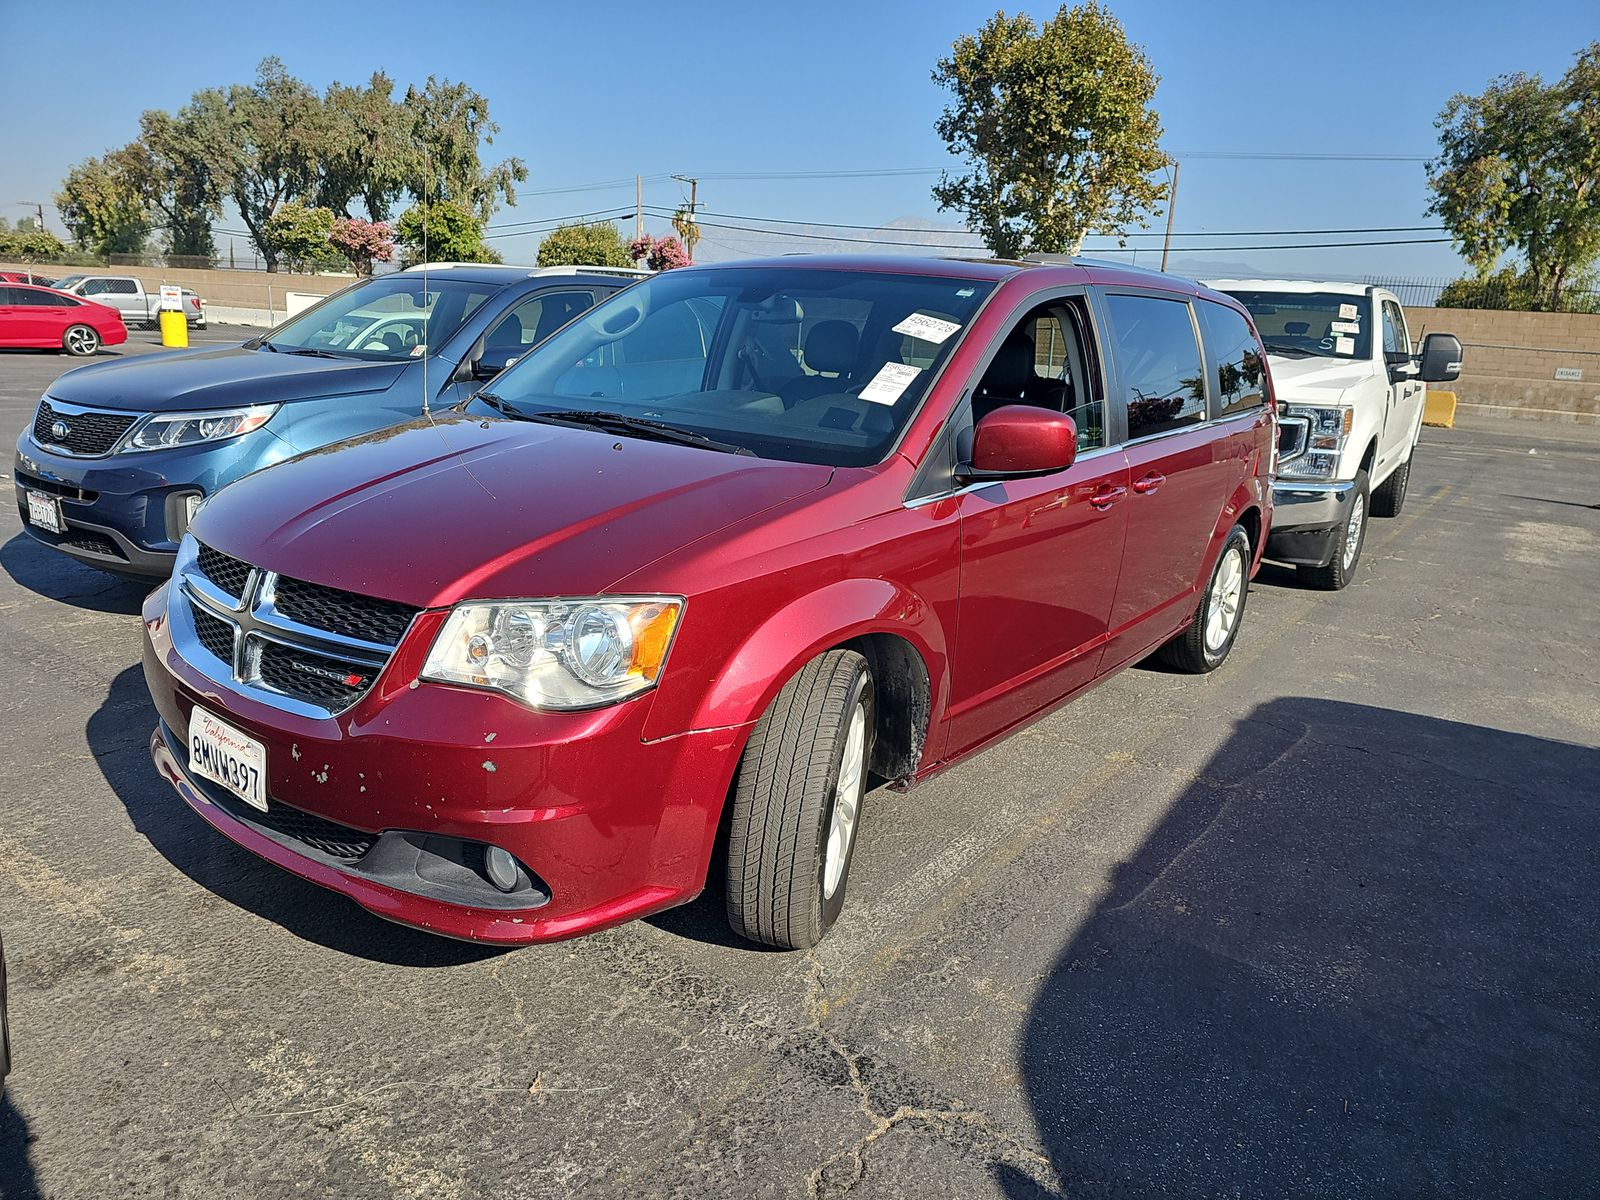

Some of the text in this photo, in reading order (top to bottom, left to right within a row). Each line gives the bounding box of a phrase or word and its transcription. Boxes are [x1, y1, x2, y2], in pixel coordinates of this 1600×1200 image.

[910, 316, 955, 333] 4562728
[52, 424, 65, 437] KIA
[292, 661, 346, 681] DODGE
[204, 719, 250, 757] California
[193, 735, 258, 800] 8MVW397
